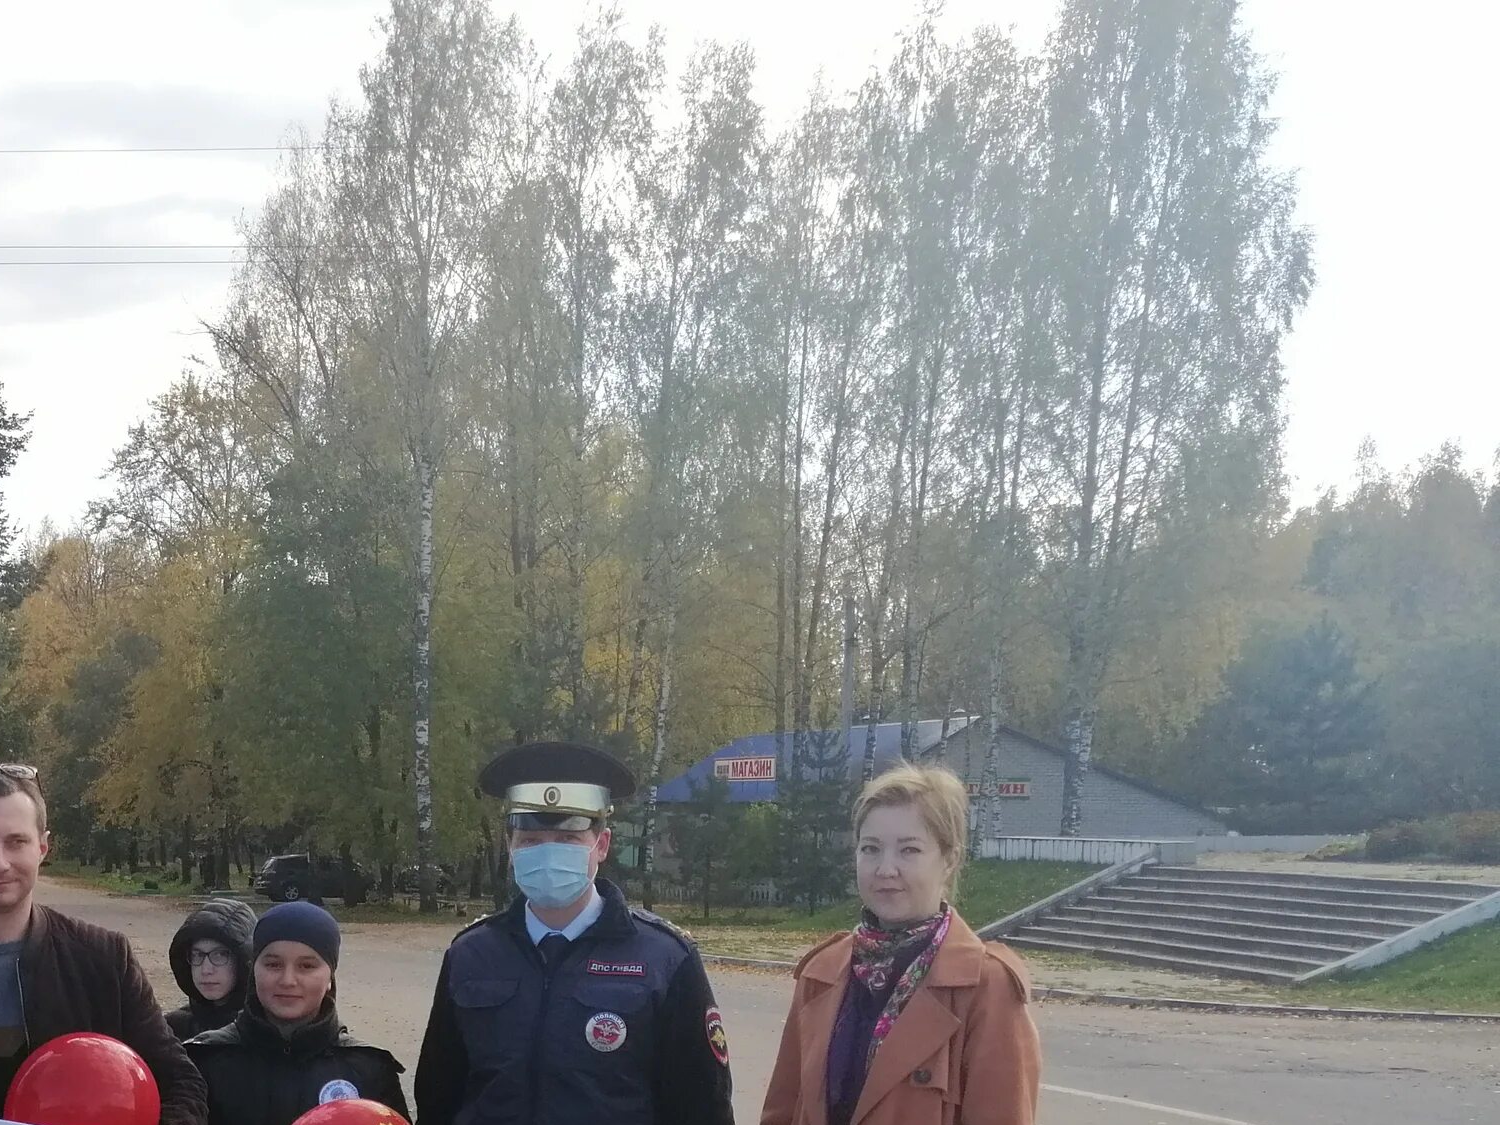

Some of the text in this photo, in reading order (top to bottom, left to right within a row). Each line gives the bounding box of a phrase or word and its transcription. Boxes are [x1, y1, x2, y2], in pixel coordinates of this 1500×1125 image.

[731, 759, 772, 777] МАГАЗИН
[591, 963, 643, 973] ДПС ГИБДД
